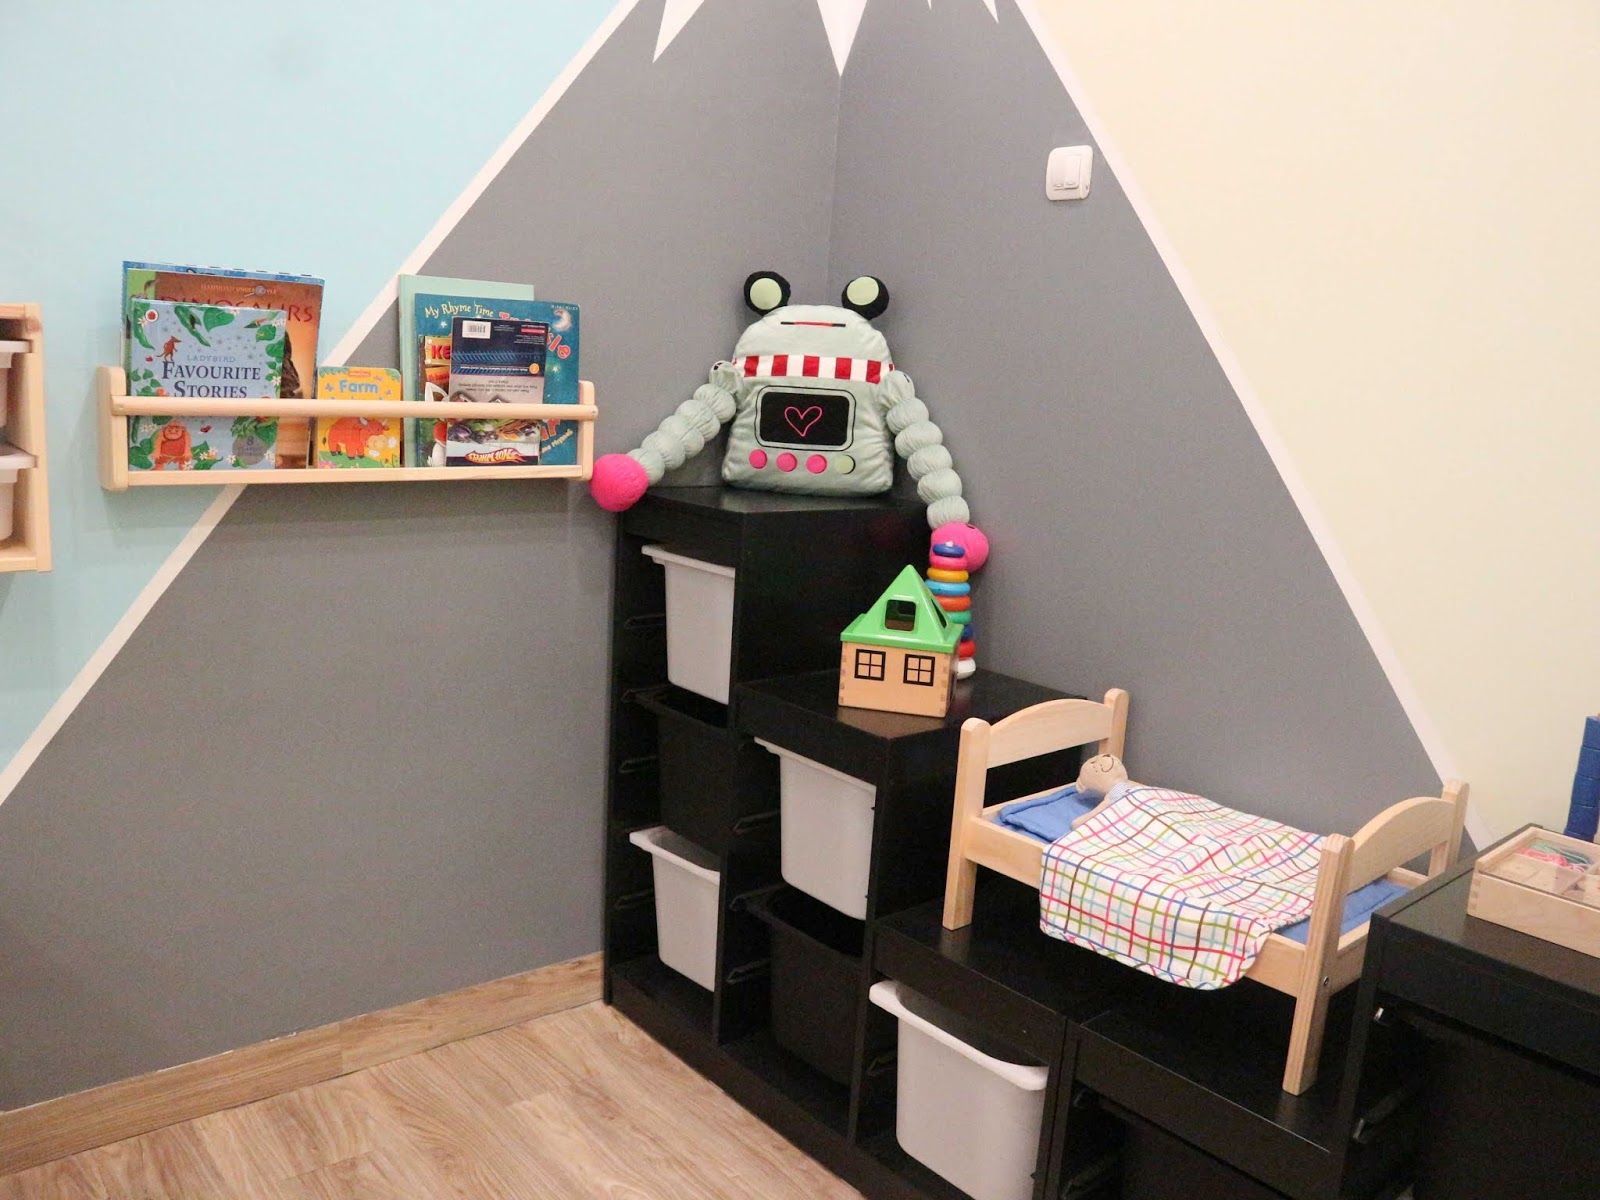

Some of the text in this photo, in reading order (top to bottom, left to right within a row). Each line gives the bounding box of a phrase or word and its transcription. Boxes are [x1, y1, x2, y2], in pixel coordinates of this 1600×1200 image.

[424, 302, 494, 318] My Rhyme Time
[187, 354, 236, 363] LADYBIRD
[161, 361, 261, 380] FAVOURITE
[174, 380, 248, 398] STORIES
[338, 379, 379, 393] Farm
[468, 449, 513, 463] HOT WHEELS
